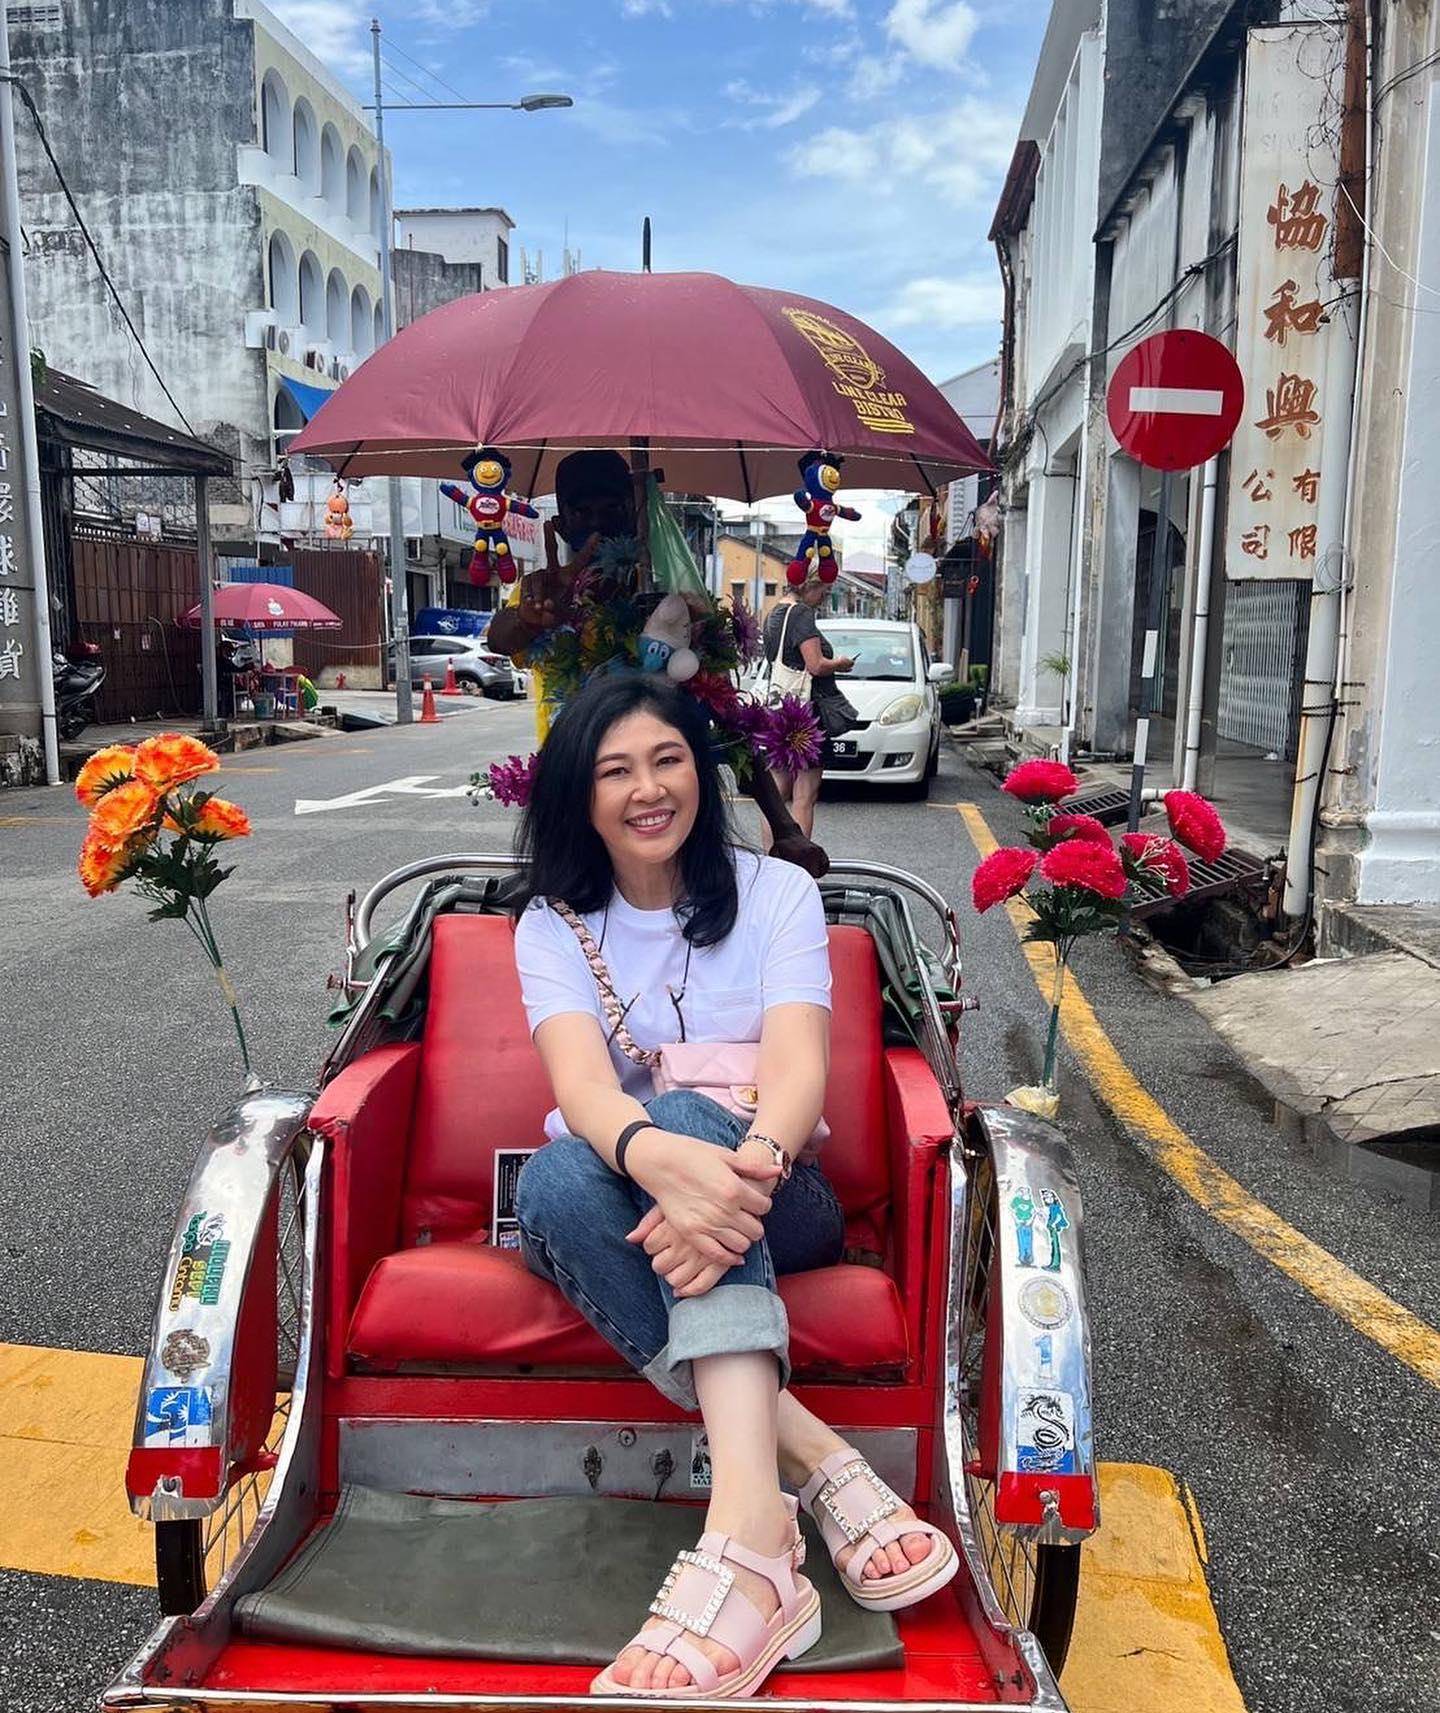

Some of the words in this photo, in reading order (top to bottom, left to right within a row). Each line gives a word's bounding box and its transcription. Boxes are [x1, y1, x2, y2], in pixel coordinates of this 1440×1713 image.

[1255, 179, 1330, 442] 協和興
[865, 390, 908, 408] CLEAR
[852, 400, 906, 421] BISTRO
